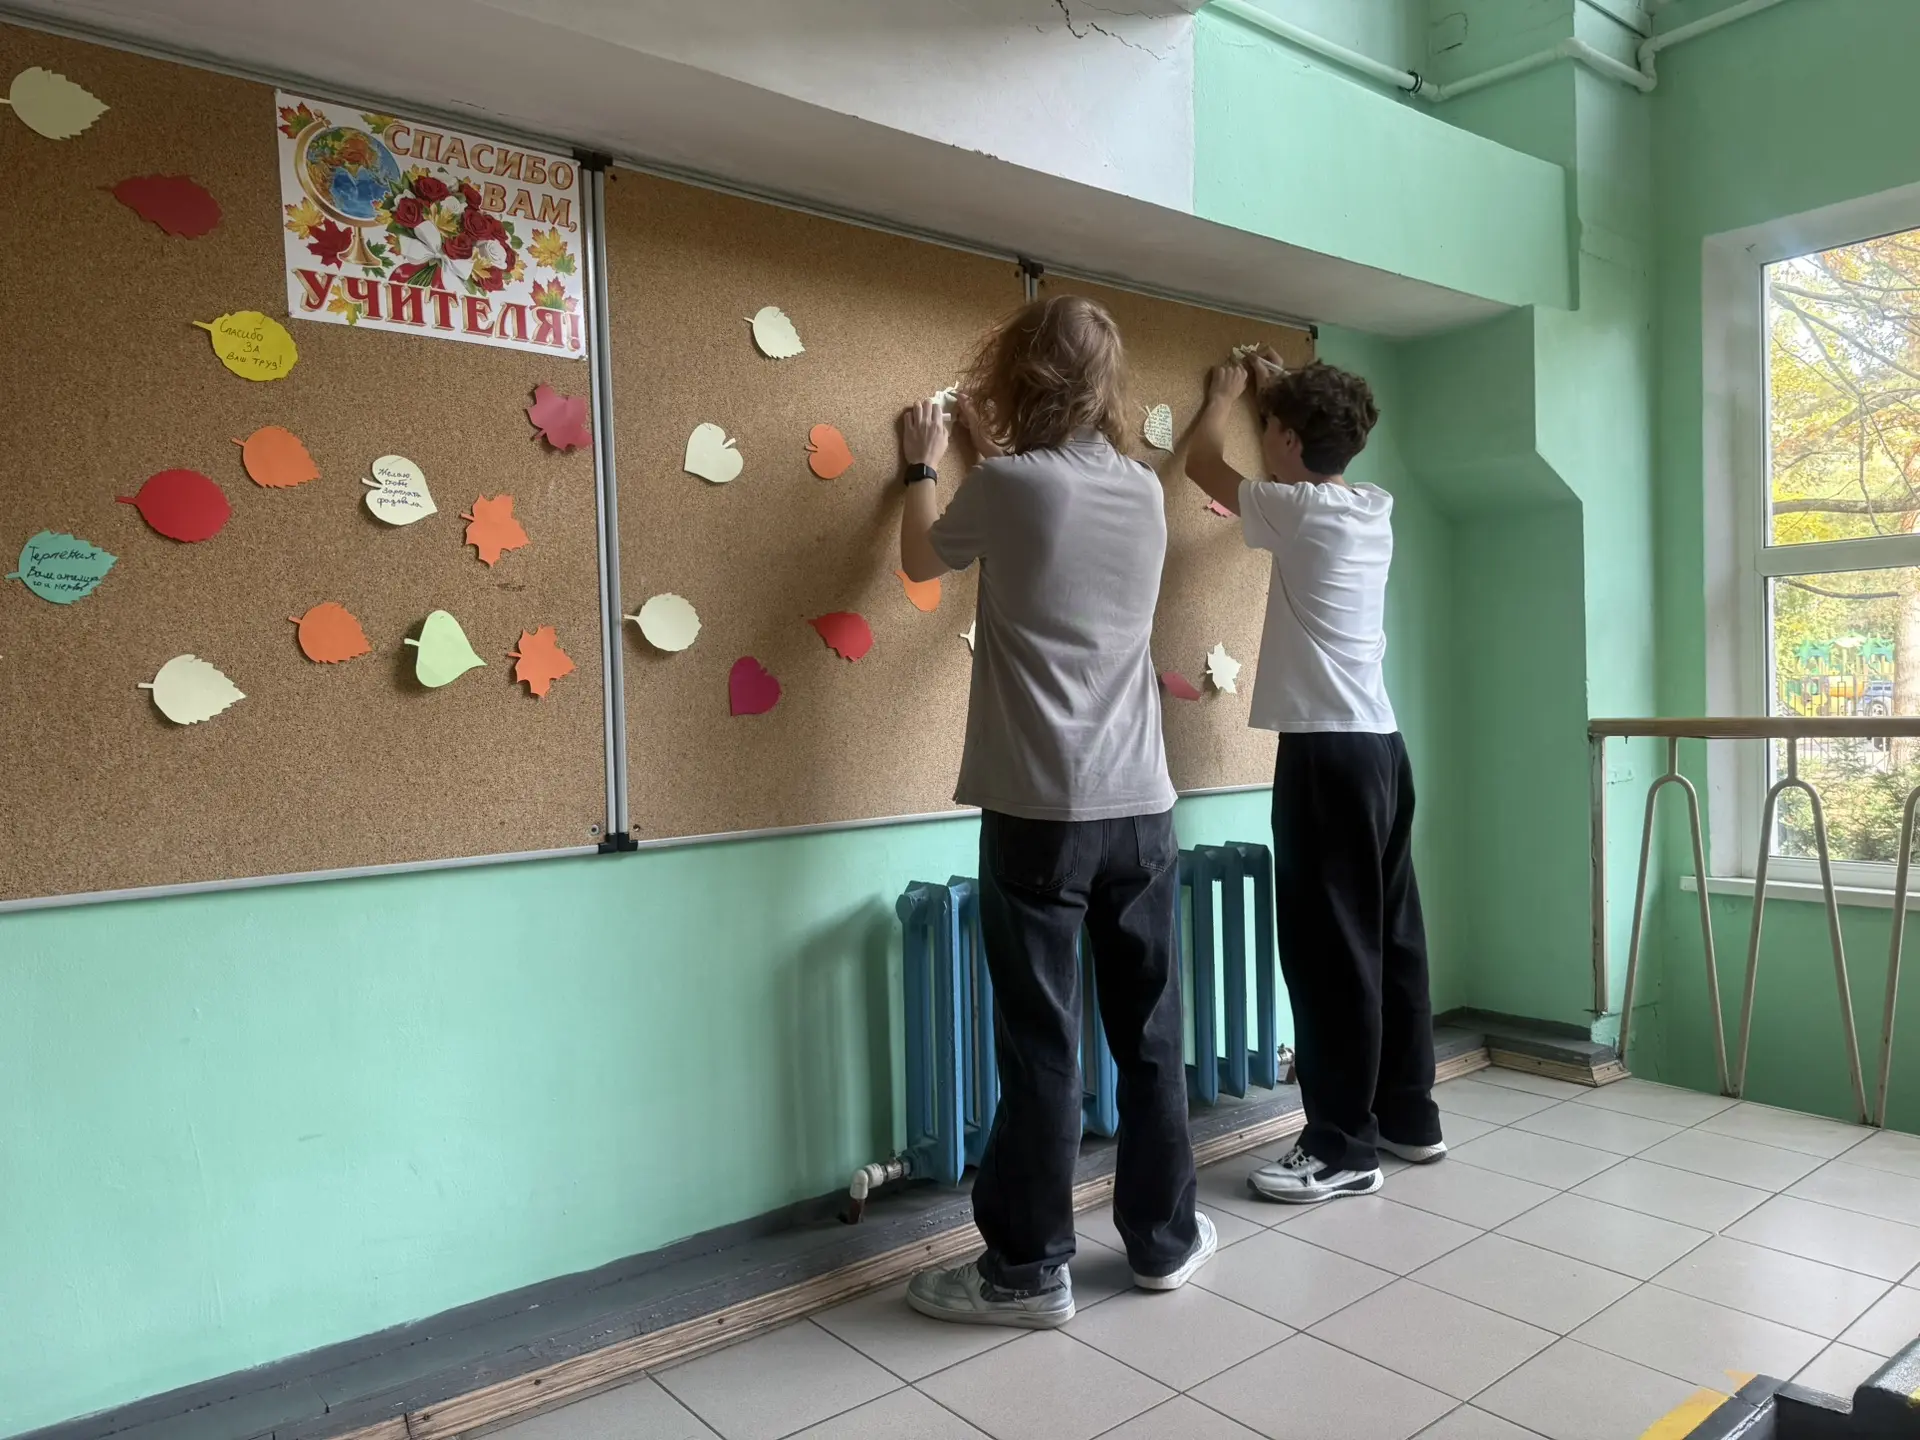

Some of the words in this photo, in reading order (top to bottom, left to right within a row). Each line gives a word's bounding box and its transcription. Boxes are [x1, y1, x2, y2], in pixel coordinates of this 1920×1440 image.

[383, 123, 574, 190] СПАСИБО
[481, 181, 577, 232] ВАМ,
[292, 267, 582, 351] УЧИТЕЛЯ!
[28, 545, 97, 565] Терпения
